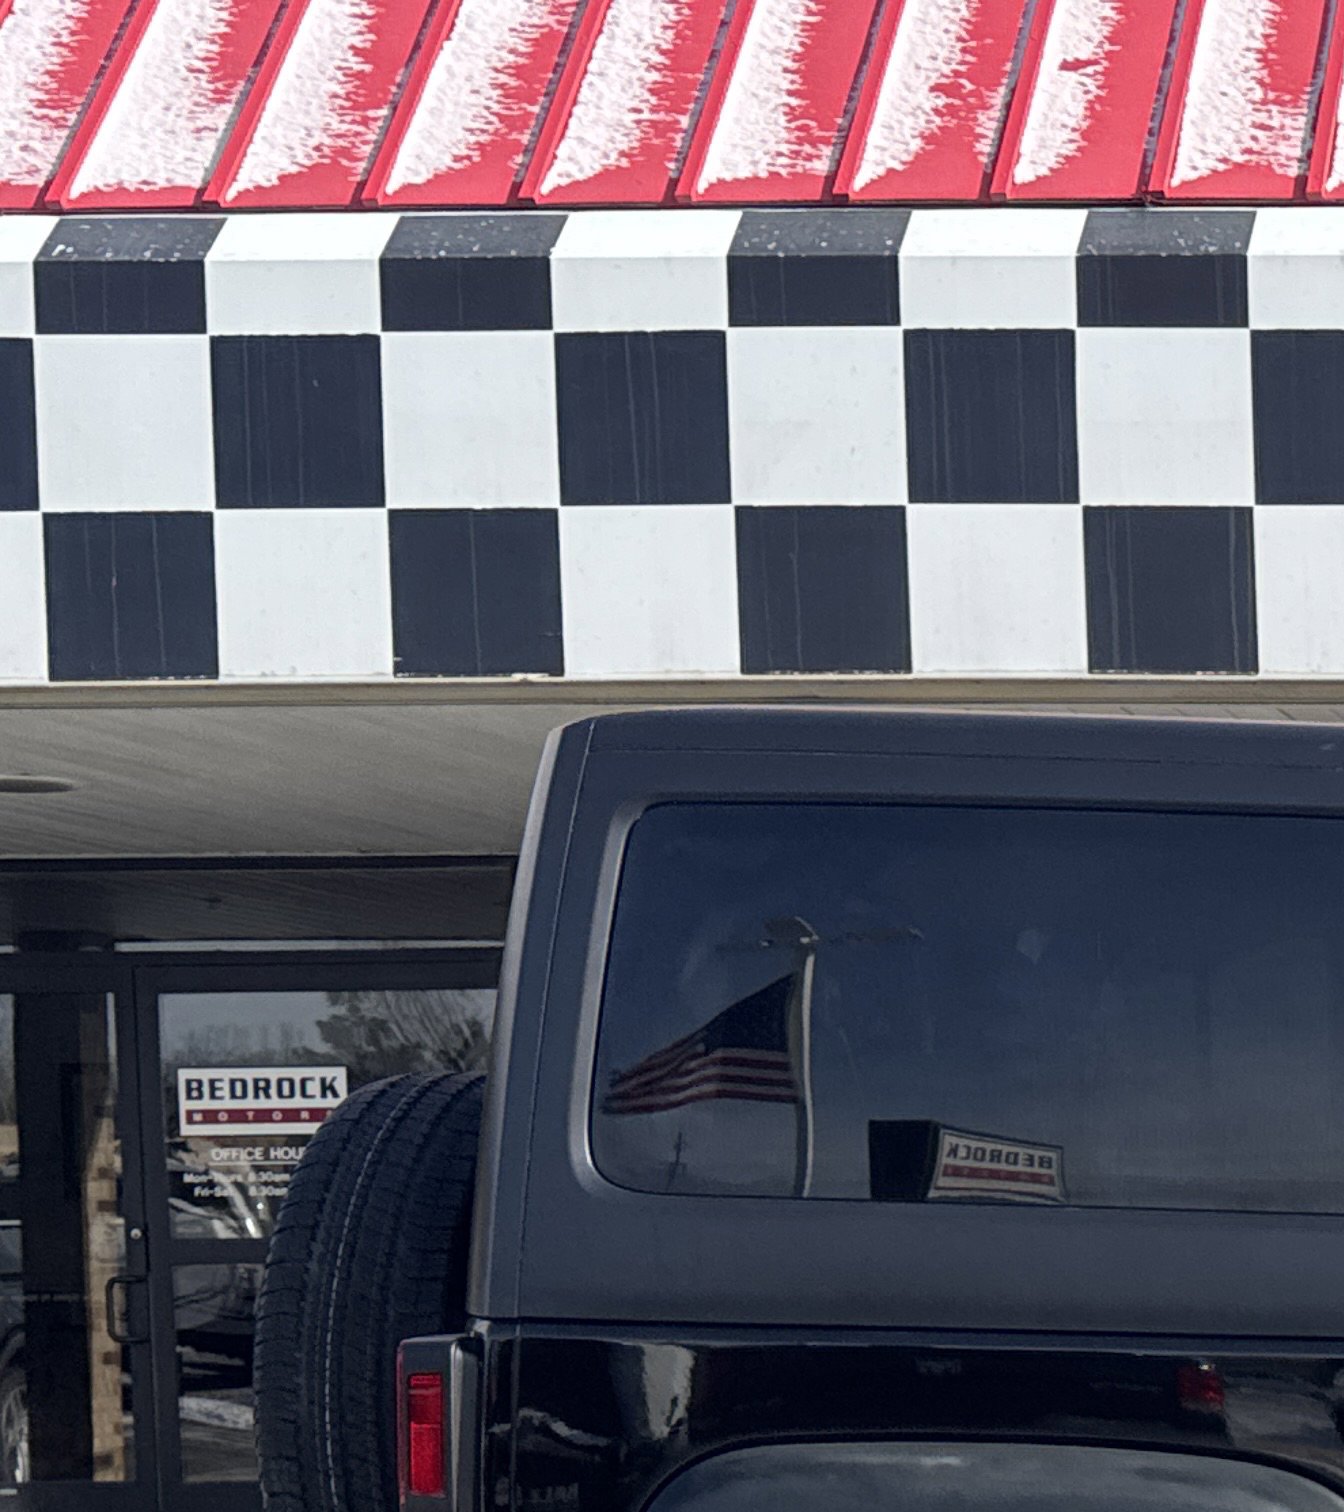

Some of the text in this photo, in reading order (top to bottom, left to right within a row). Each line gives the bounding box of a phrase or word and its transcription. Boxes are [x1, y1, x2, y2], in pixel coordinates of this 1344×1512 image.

[185, 1077, 339, 1100] BEDROCK
[211, 1145, 306, 1161] OFFICE HOU
